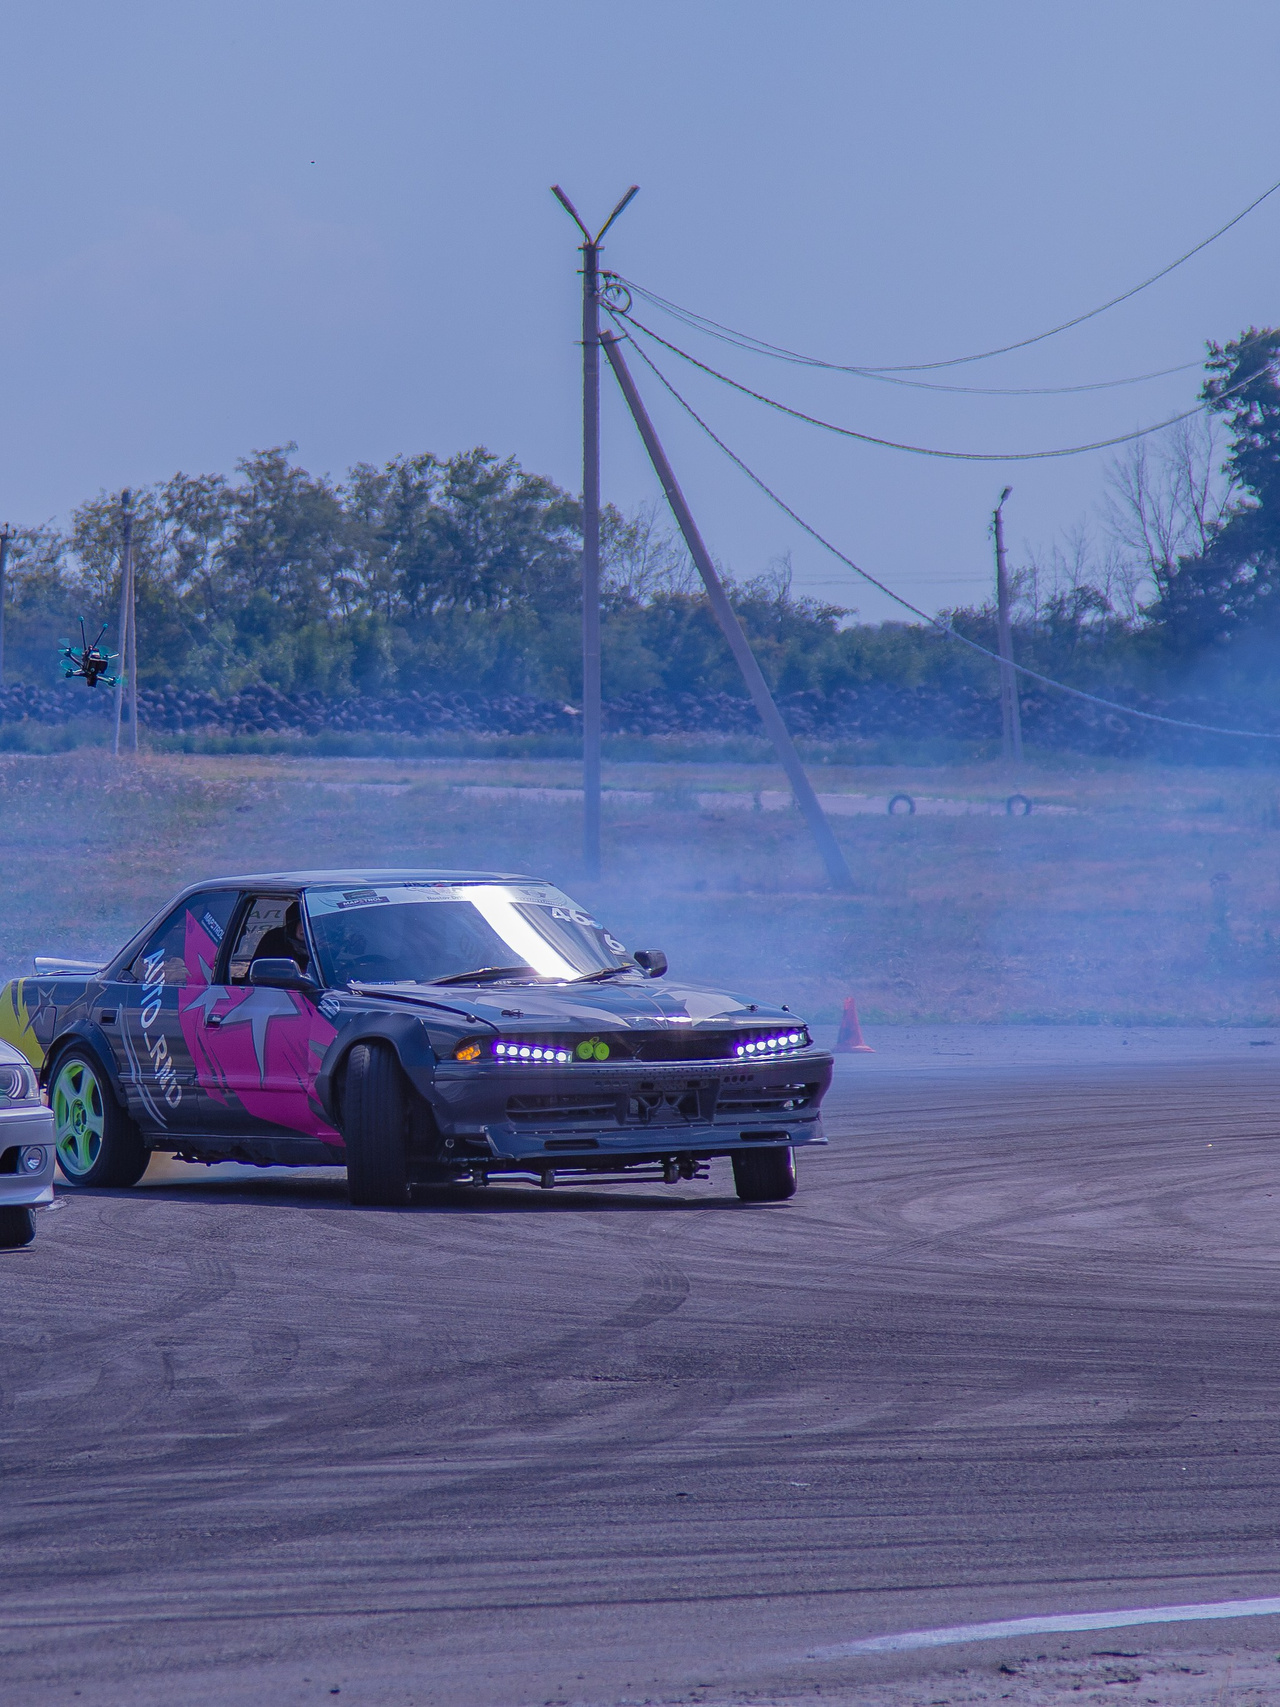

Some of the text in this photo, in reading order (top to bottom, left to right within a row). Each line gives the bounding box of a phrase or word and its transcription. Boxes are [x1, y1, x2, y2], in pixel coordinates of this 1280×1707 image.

[203, 911, 225, 940] MAPETROL
[551, 907, 591, 926] 46
[604, 934, 627, 952] 6
